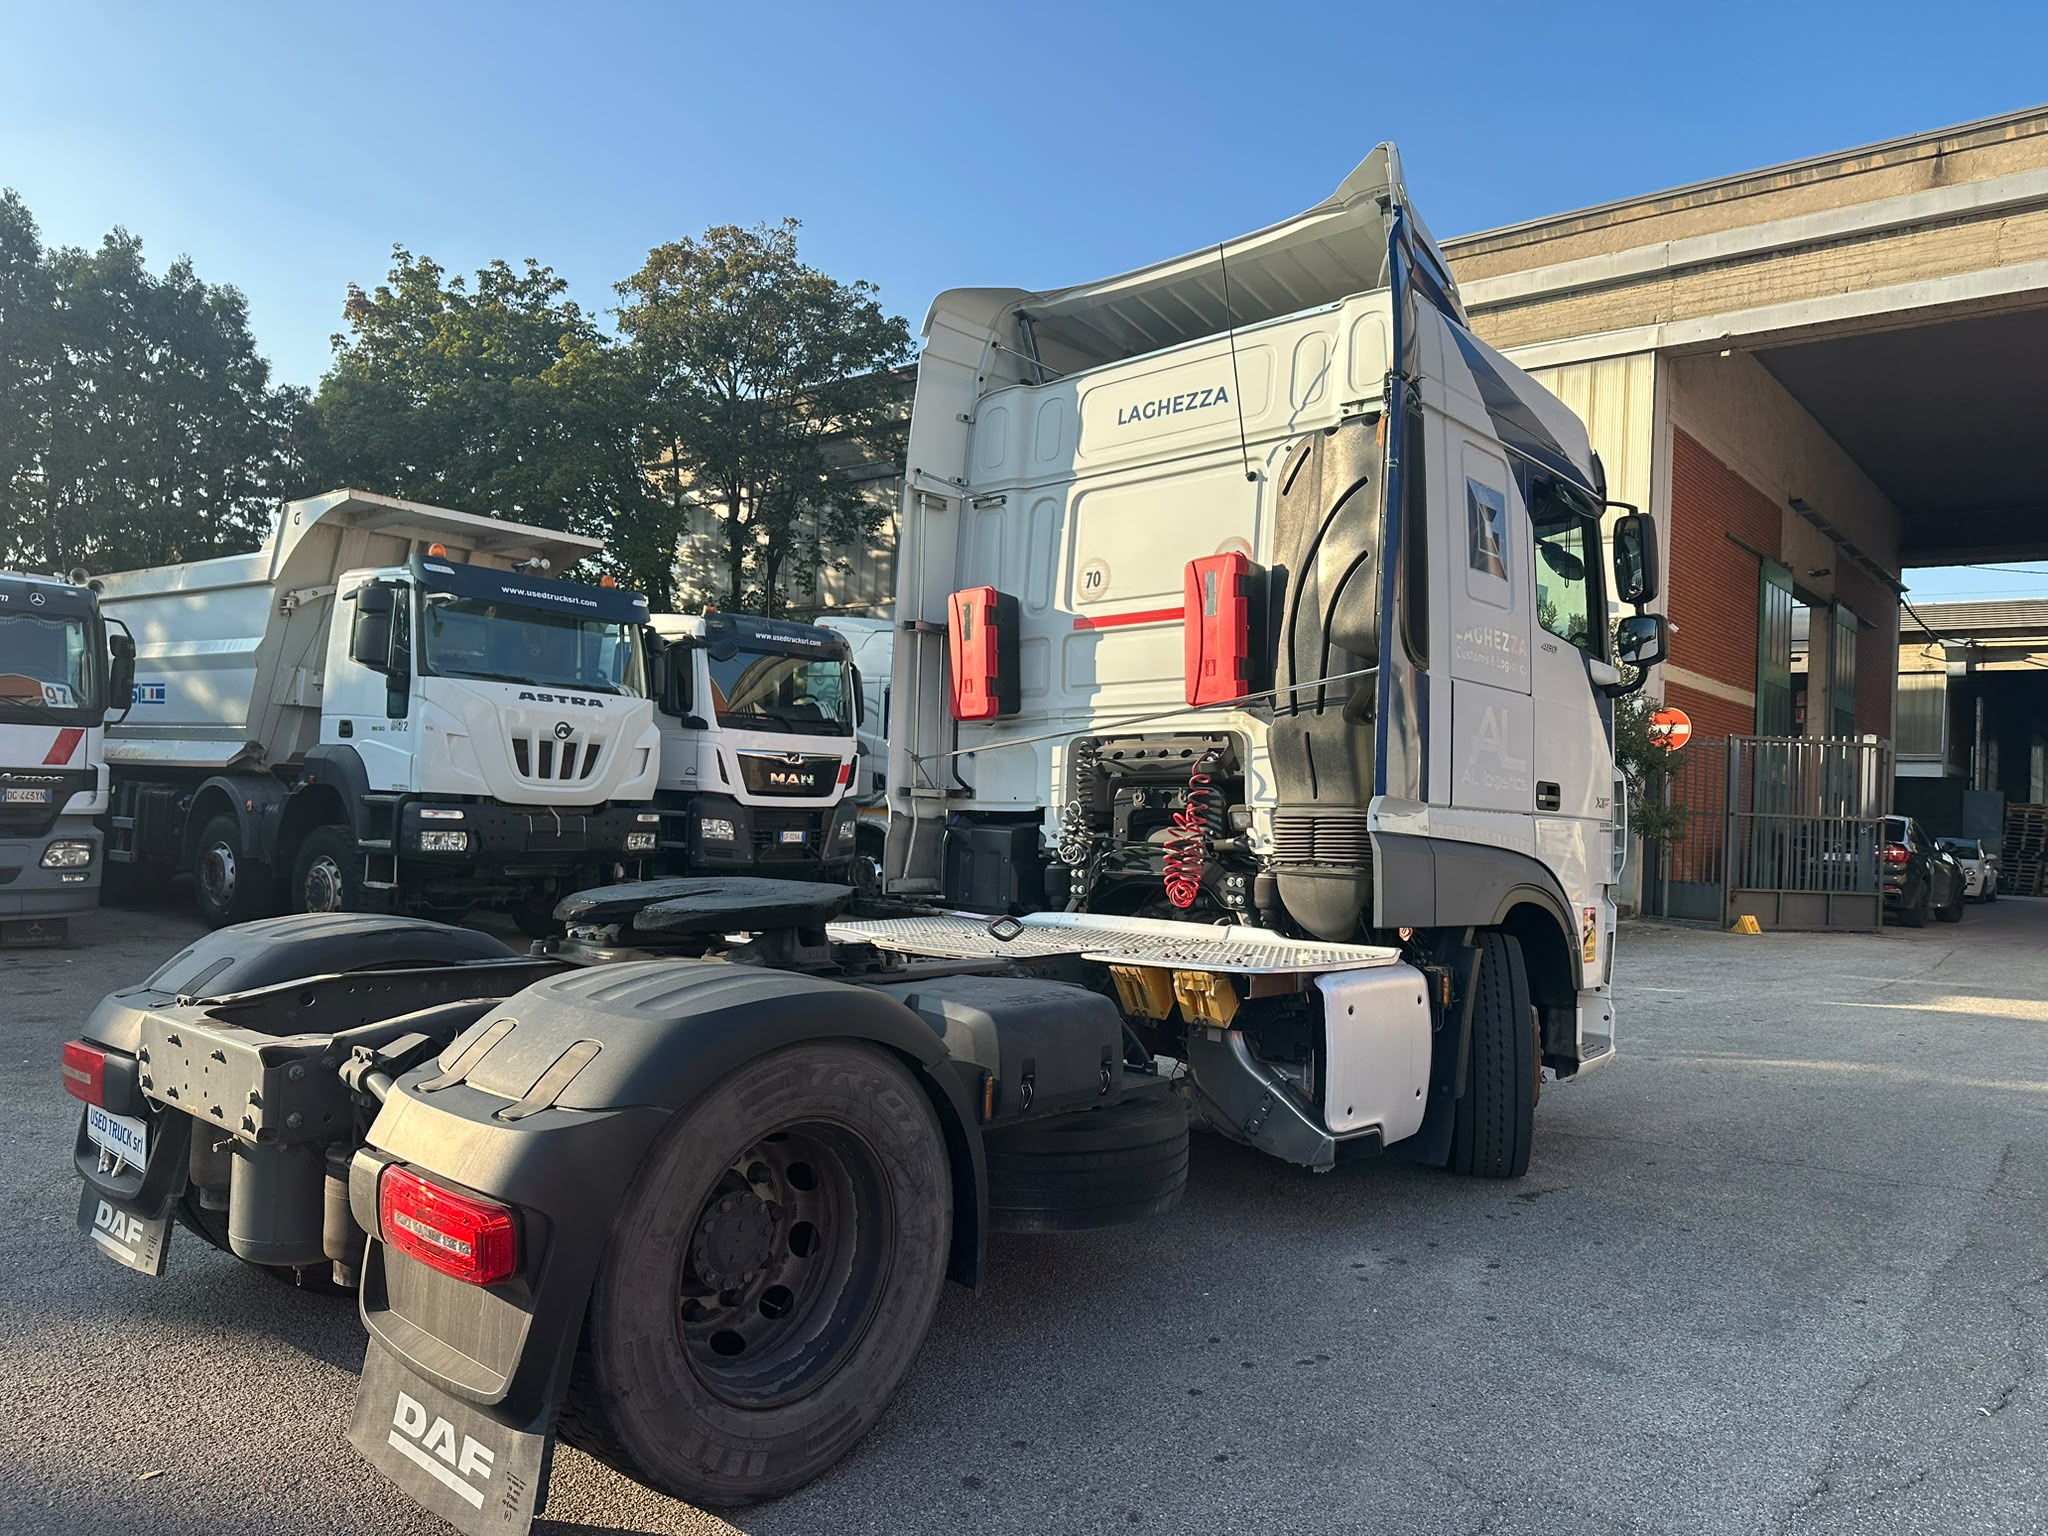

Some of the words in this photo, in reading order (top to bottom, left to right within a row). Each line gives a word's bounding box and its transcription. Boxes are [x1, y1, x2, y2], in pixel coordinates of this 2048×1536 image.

[1117, 386, 1229, 425] LAGHEZZA
[1086, 570, 1101, 589] 70
[45, 685, 68, 705] 97
[518, 691, 604, 708] ASTRA
[770, 772, 815, 786] MAN
[89, 1107, 107, 1133] USED
[108, 1121, 132, 1147] TRUCK
[132, 1137, 143, 1155] srl
[94, 1199, 144, 1245] DAF
[392, 1390, 495, 1480] DAF
